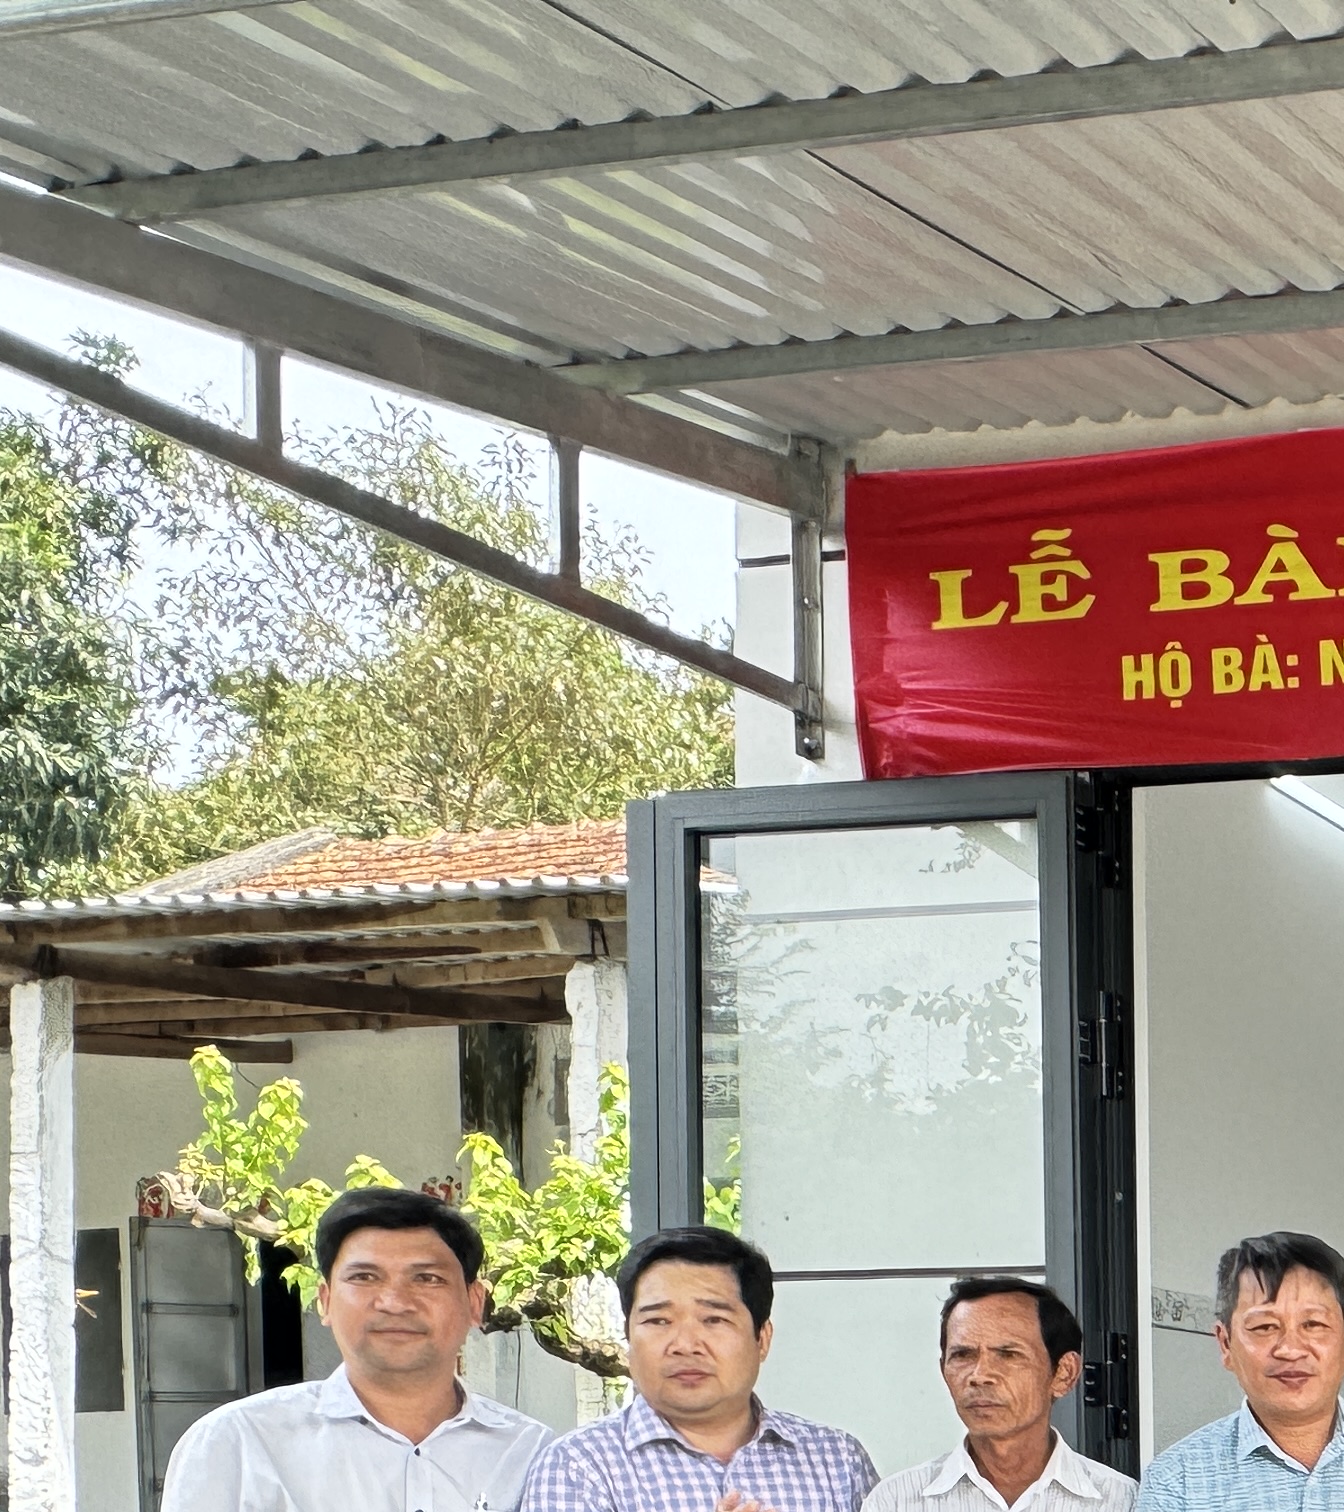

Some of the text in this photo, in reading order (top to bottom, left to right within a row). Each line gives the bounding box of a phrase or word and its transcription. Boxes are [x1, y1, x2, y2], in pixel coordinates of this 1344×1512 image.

[929, 527, 1096, 632] LỄ
[1121, 640, 1193, 709] HỘ
[1211, 633, 1300, 695] BÀ:
